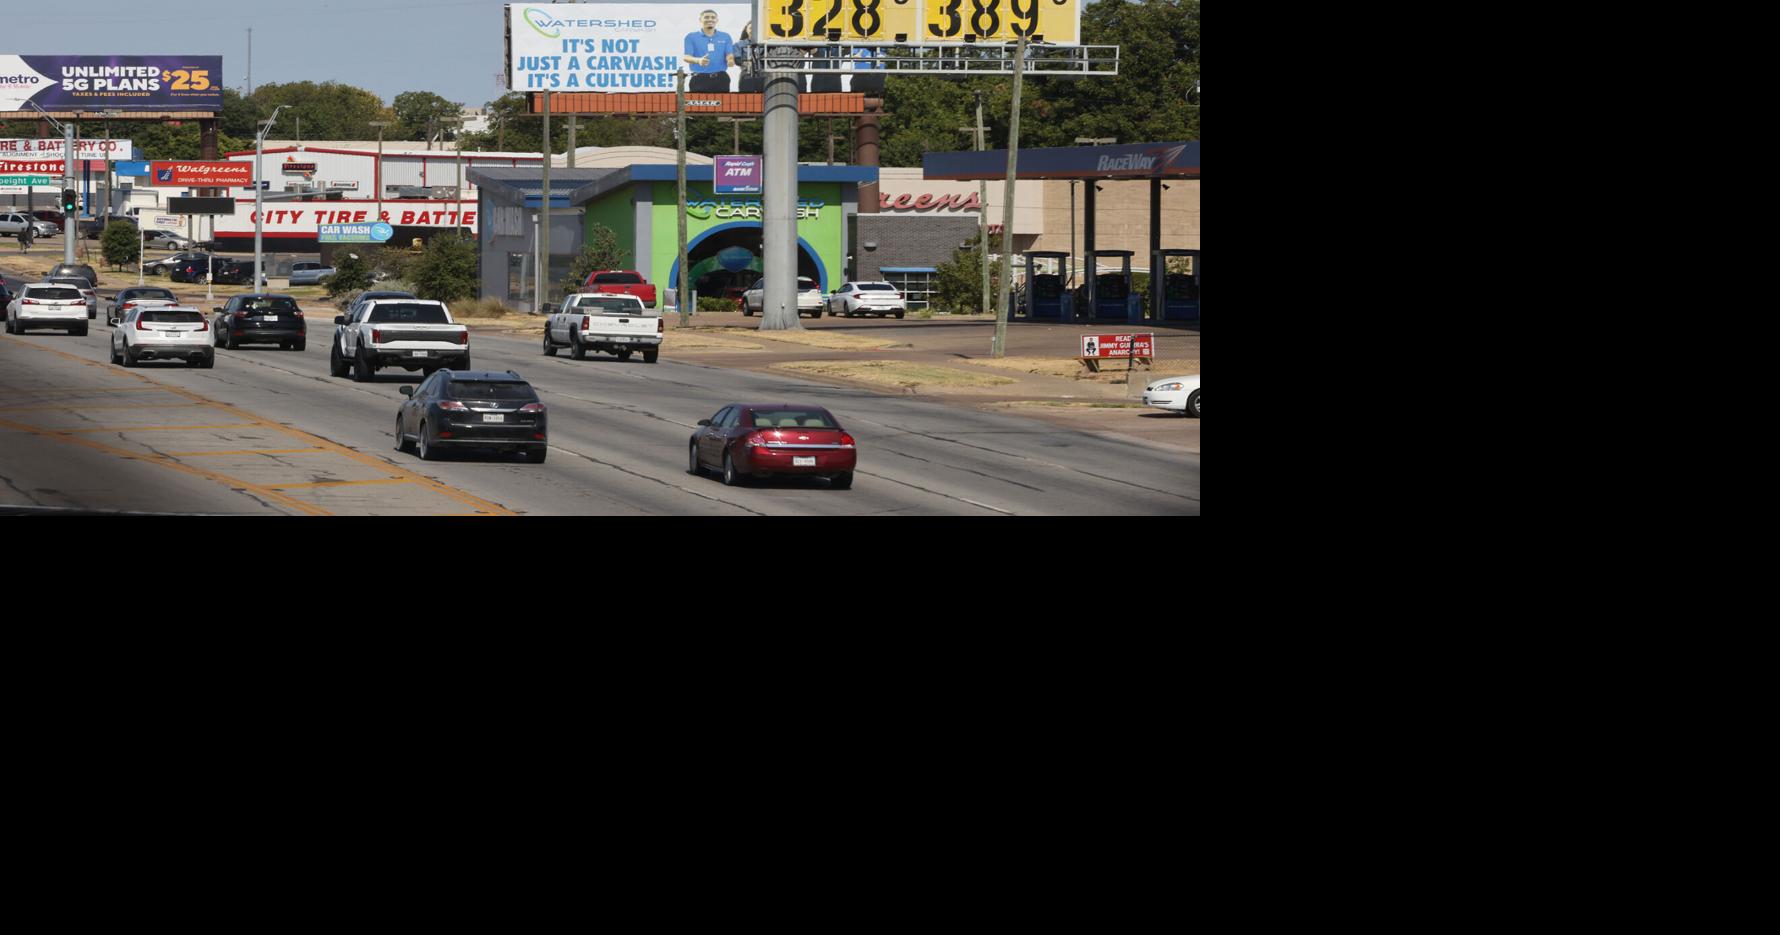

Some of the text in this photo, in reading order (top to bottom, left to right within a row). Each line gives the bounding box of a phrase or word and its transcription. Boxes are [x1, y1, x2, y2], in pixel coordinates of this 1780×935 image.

[534, 20, 657, 28] WATERSHED
[562, 39, 640, 53] IT'S NOT
[517, 56, 677, 71] JUST A CARWASH
[62, 66, 160, 77] UNLIMITED
[62, 79, 160, 91] 5G PLANS
[162, 69, 210, 90] $25
[528, 73, 674, 88] IT'S A CULTURE!
[24, 140, 31, 151] &
[38, 141, 96, 151] BATRY
[176, 165, 248, 175] Walgreens
[725, 168, 753, 176] ATM
[250, 210, 476, 225] CITY TIRE & BATTE
[716, 207, 819, 218] CARSH
[321, 225, 371, 234] CAR WASH
